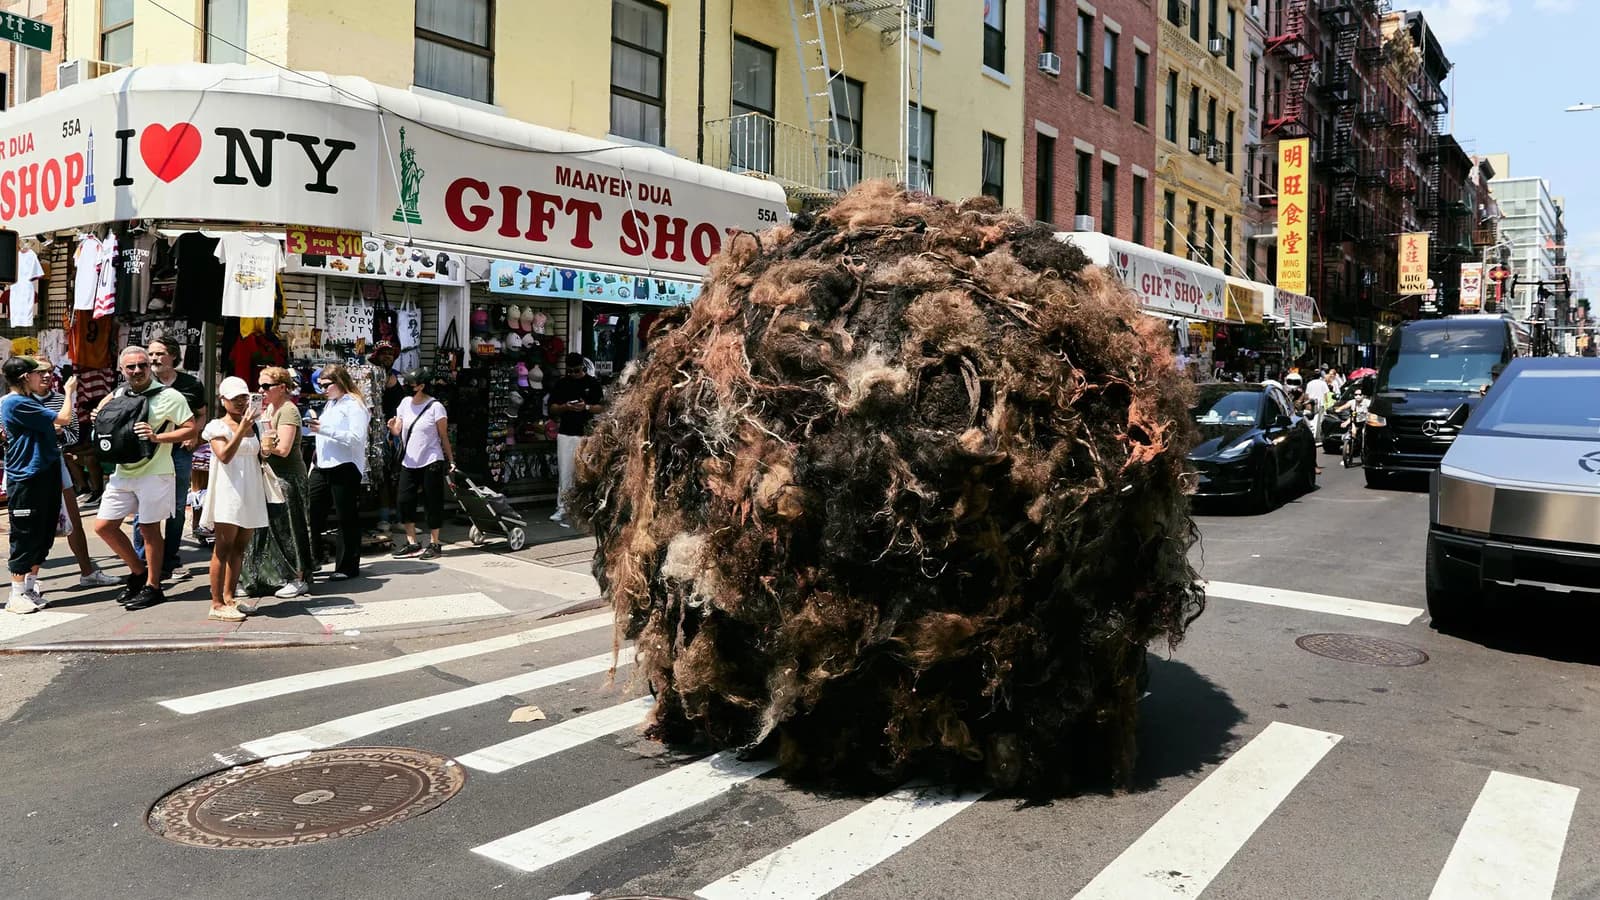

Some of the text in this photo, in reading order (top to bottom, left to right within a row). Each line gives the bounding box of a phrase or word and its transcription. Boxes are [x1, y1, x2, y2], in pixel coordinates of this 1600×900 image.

[33, 22, 46, 33] St
[62, 118, 81, 139] 55A
[9, 132, 35, 157] DUA
[113, 127, 357, 195] I NY
[0, 152, 84, 221] SHOP
[555, 165, 673, 207] MAAYER DUA
[1281, 144, 1304, 255] 明旺食堂
[444, 176, 736, 266] GIFT SHO
[757, 207, 779, 223] 55A
[290, 231, 362, 256] 3 FOR $10
[1280, 270, 1301, 279] WONG
[1282, 259, 1300, 268] MING
[1141, 273, 1172, 298] GIFT
[1174, 281, 1204, 305] SHOP
[1399, 283, 1426, 292] WONG
[1404, 274, 1421, 283] BIG
